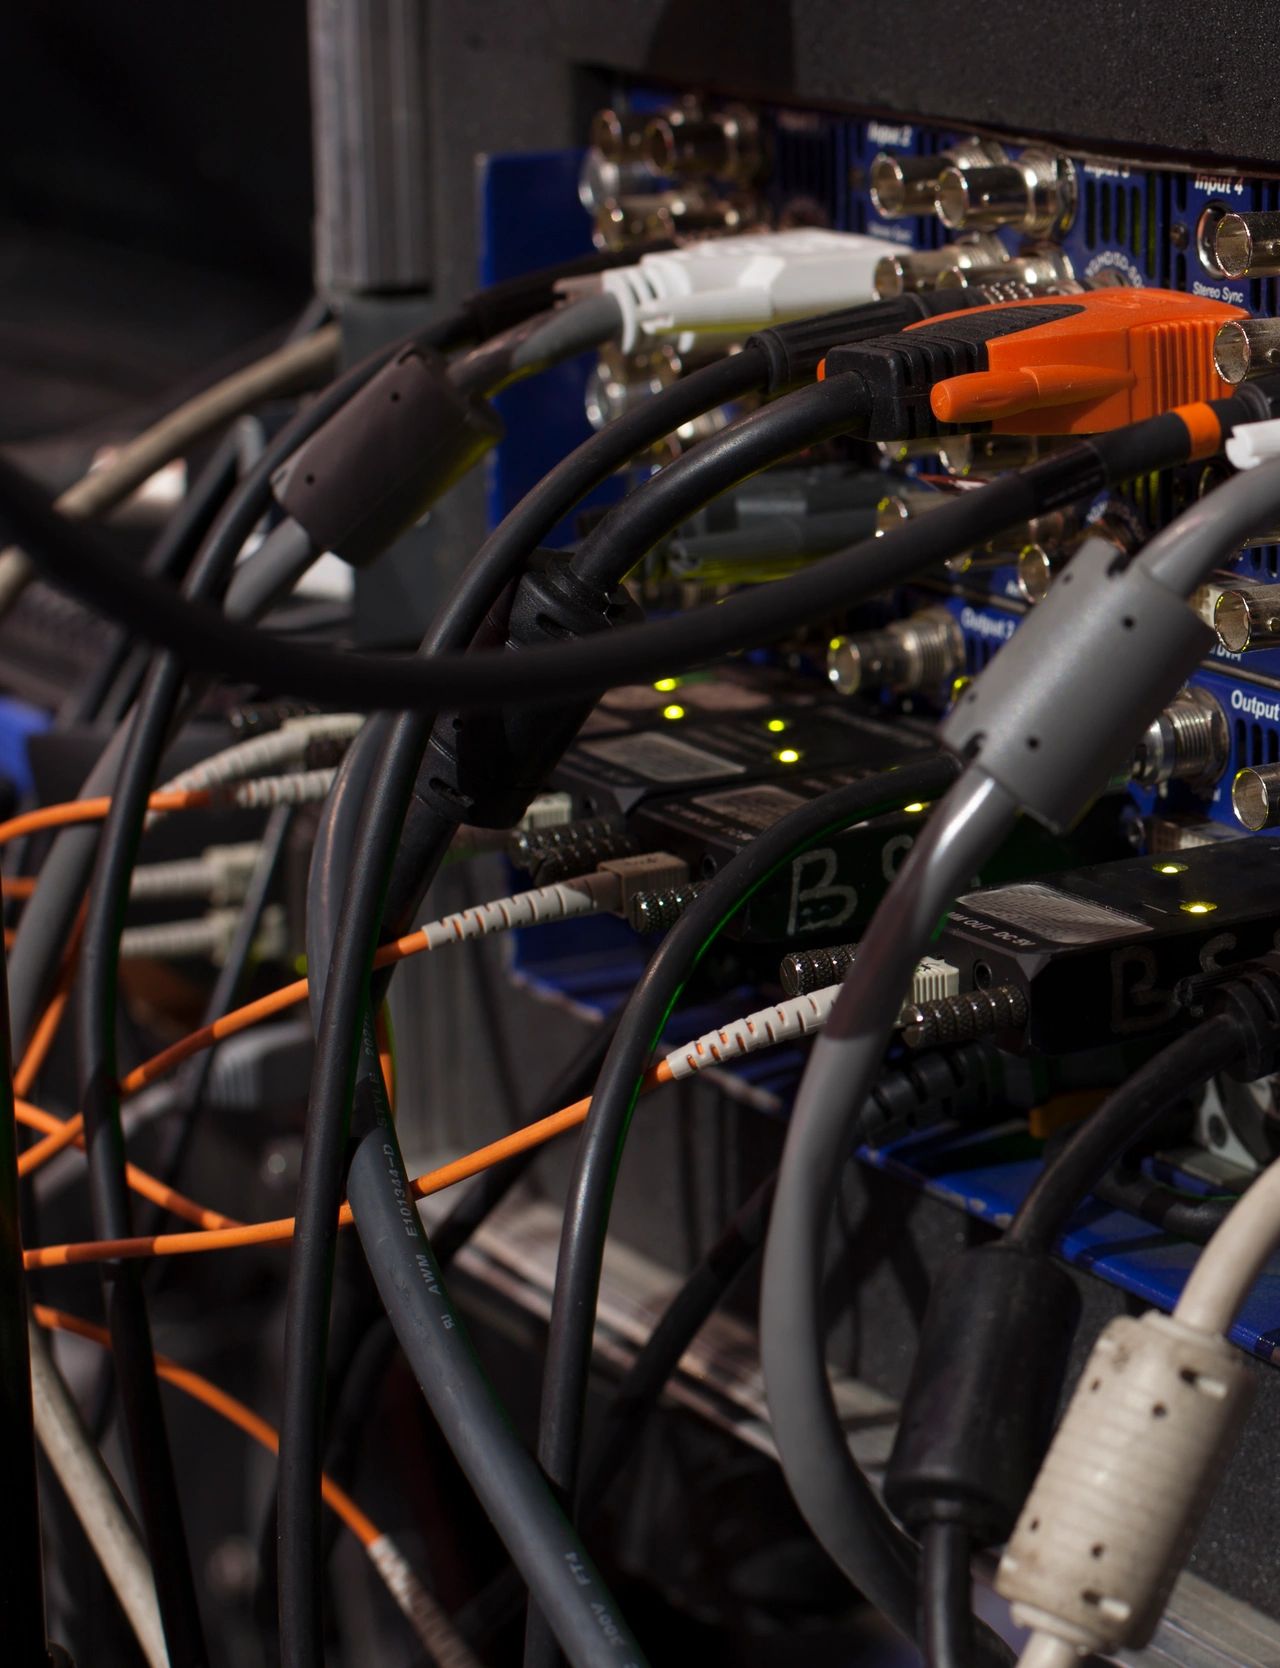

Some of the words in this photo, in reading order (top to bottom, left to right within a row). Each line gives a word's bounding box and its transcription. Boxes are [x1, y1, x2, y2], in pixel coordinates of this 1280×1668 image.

[1194, 173, 1231, 196] Input
[1233, 175, 1245, 196] 4
[1193, 280, 1220, 300] Stereo
[1221, 286, 1245, 304] Sync
[1231, 689, 1280, 721] Output
[415, 1253, 441, 1296] AWM
[564, 1551, 592, 1585] FT4
